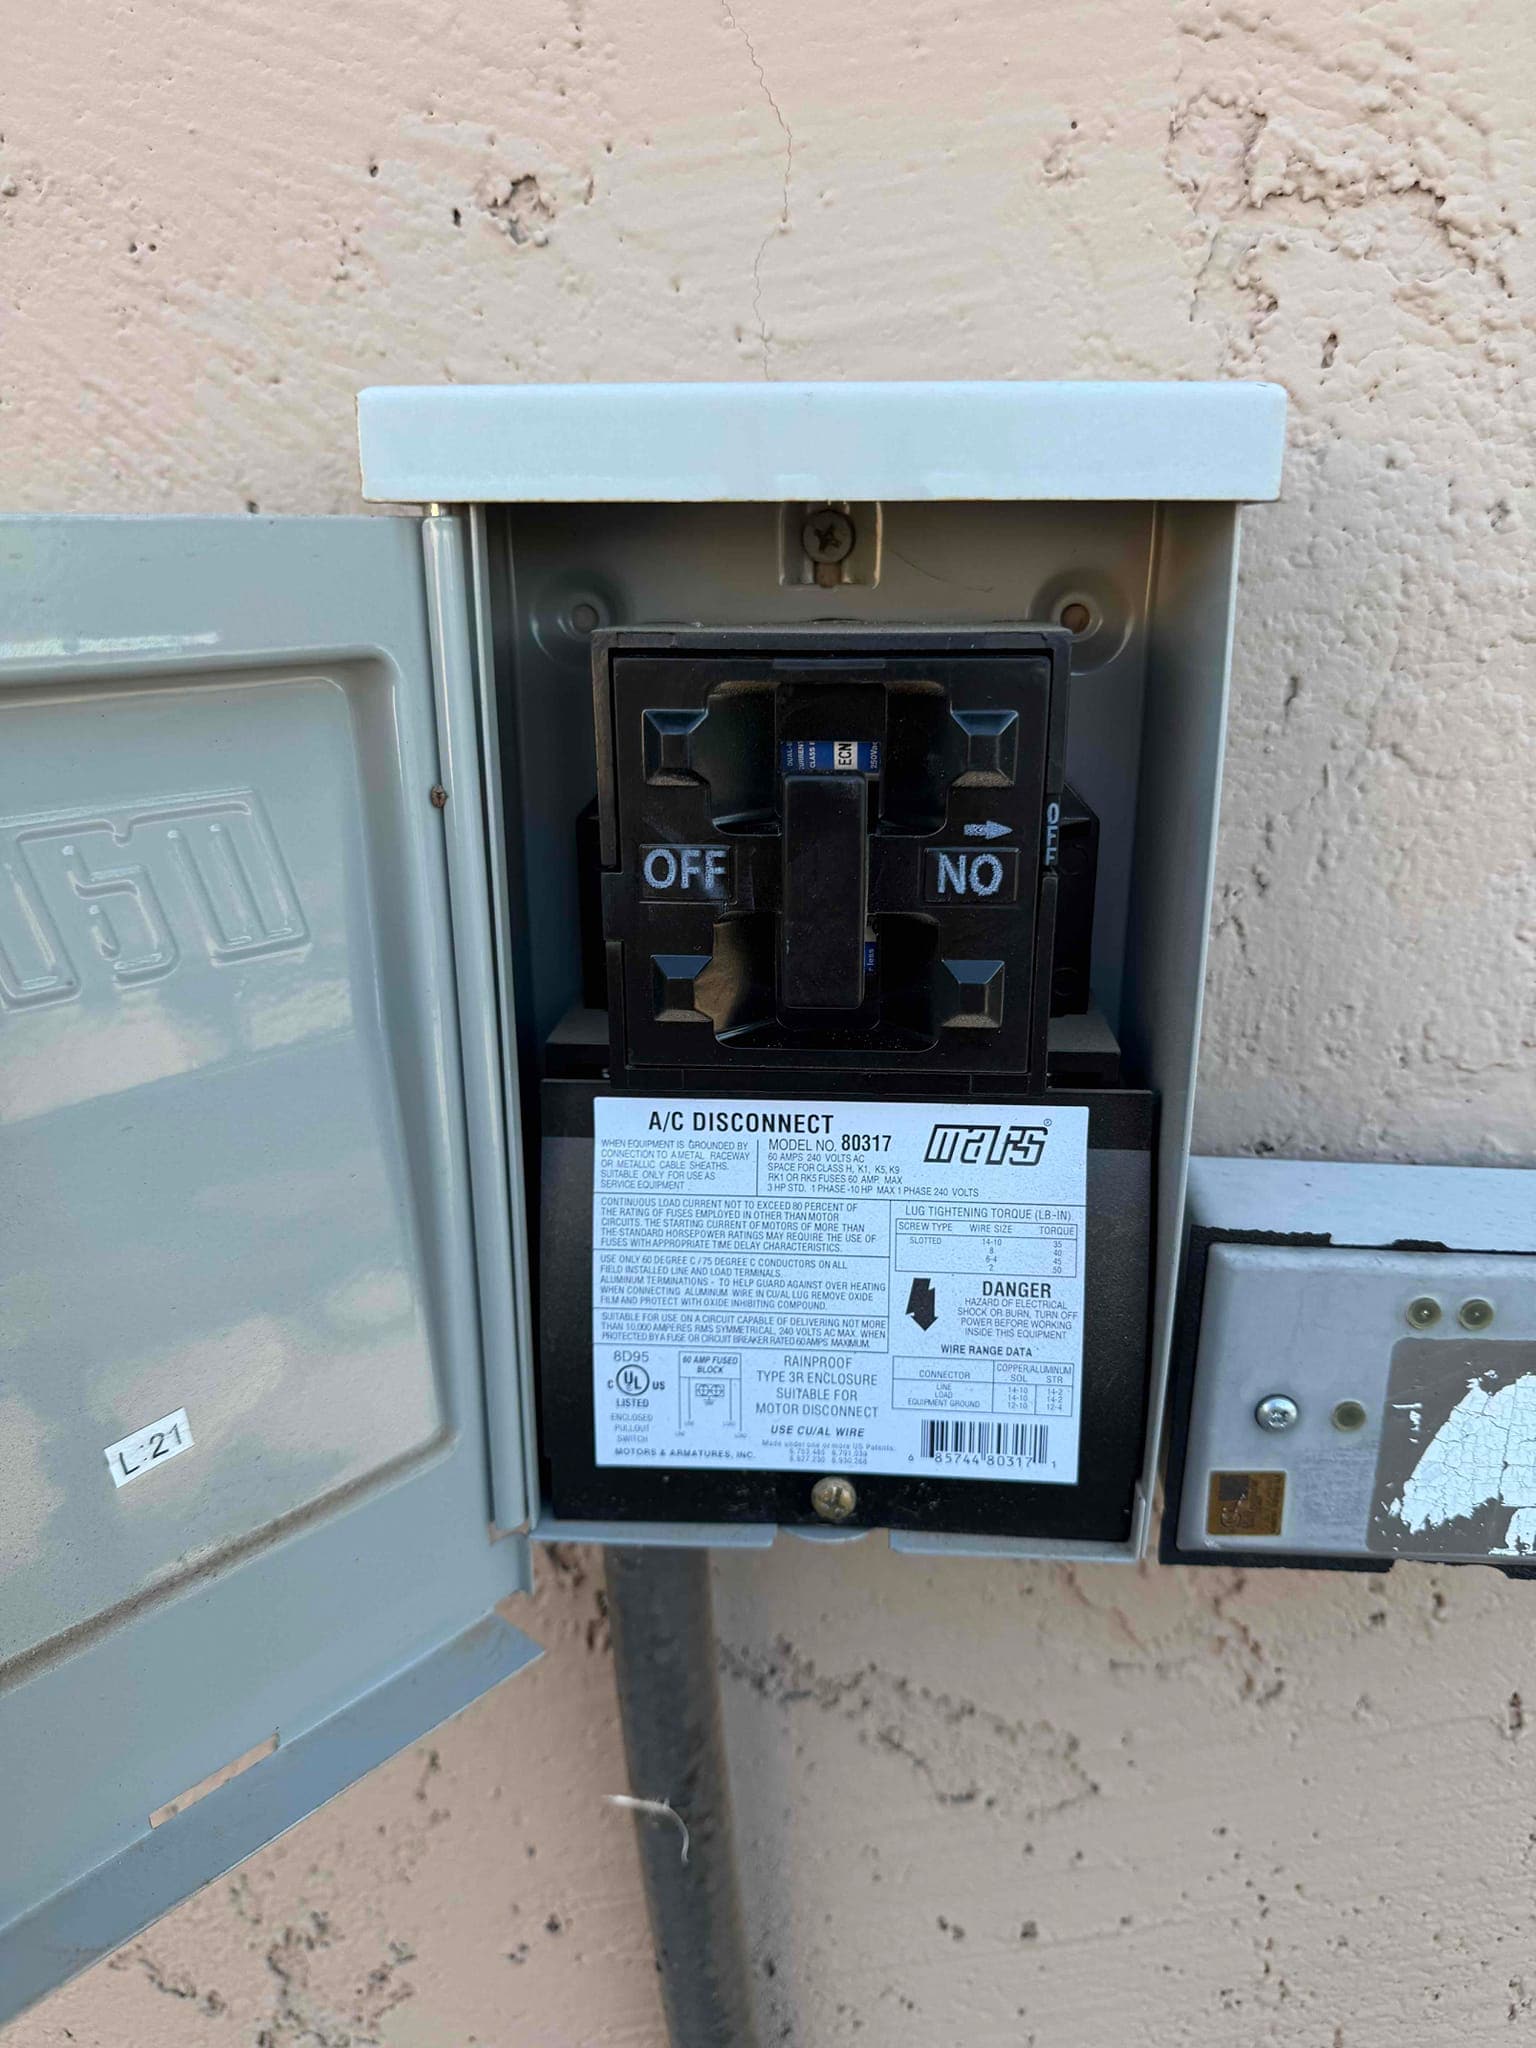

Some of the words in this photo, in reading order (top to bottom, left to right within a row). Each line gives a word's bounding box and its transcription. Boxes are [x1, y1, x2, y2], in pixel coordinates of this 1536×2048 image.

[644, 848, 728, 890] OFF
[648, 1110, 683, 1132] A/C
[693, 1111, 833, 1134] DISCONNECT
[600, 1138, 625, 1147] WHEN
[627, 1138, 674, 1149] EQUIPMENT
[676, 1140, 684, 1149] IS
[688, 1140, 735, 1150] GROUNDED
[737, 1141, 748, 1150] BY
[768, 1137, 812, 1151] MODEL
[816, 1138, 836, 1151] NO.
[841, 1133, 891, 1151] 80317
[600, 1148, 654, 1158] CONNECTION
[656, 1149, 667, 1158] TO
[670, 1150, 676, 1158] A
[677, 1150, 704, 1160] METAL
[710, 1151, 750, 1160] RACEWAY
[767, 1152, 777, 1161] 60
[779, 1152, 803, 1161] AMPS
[806, 1153, 821, 1162] 240
[824, 1153, 851, 1162] VOLTS
[852, 1154, 864, 1163] AC
[600, 1158, 613, 1168] OR
[616, 1158, 655, 1168] METALLIC
[658, 1160, 685, 1170] CABLE
[689, 1160, 729, 1170] SHEATHS.
[767, 1162, 795, 1171] SPACE
[797, 1163, 814, 1172] FOR
[816, 1163, 843, 1173] CLASS
[845, 1164, 854, 1174] H,
[856, 1164, 870, 1174] K1,
[874, 1165, 887, 1174] K5,
[888, 1165, 900, 1174] K9
[600, 1168, 638, 1178] SUITABLE
[640, 1169, 664, 1179] ONLY
[667, 1170, 684, 1179] FOR
[686, 1170, 703, 1180] USE
[704, 1171, 715, 1180] AS
[767, 1172, 783, 1181] RK1
[785, 1173, 798, 1182] OR
[800, 1173, 816, 1182] RK5
[818, 1173, 846, 1183] FUSES
[847, 1174, 857, 1183] 60
[860, 1174, 879, 1184] AMP.
[884, 1175, 902, 1184] MAX
[600, 1178, 635, 1189] SERVICE
[636, 1179, 684, 1190] EQUIPMENT
[767, 1182, 772, 1191] 3
[774, 1182, 786, 1192] HP
[787, 1182, 806, 1192] STD.
[810, 1184, 814, 1192] 1
[817, 1183, 845, 1193] PHASE
[847, 1184, 859, 1193] -10
[860, 1184, 872, 1194] HP
[876, 1185, 895, 1194] MAX
[897, 1186, 901, 1194] 1
[903, 1186, 931, 1195] PHASE
[933, 1187, 948, 1196] 240
[951, 1187, 978, 1198] VOLTS
[906, 1206, 925, 1216] LUG
[928, 1205, 987, 1218] TIGHTENING
[990, 1207, 1032, 1219] TORQUE
[1034, 1209, 1071, 1222] (LB-IN)
[898, 1221, 929, 1231] SCREW
[931, 1222, 952, 1231] TYPE
[969, 1223, 990, 1233] WIRE
[993, 1224, 1012, 1233] SIZE
[1038, 1225, 1074, 1235] TORQUE
[982, 1238, 1002, 1246] 14-10
[1054, 1258, 1062, 1266] 45
[1054, 1266, 1062, 1274] 50
[982, 1280, 1051, 1298] DANGER
[964, 1296, 999, 1308] HAZARD
[1001, 1298, 1013, 1307] OF
[1015, 1298, 1068, 1310] ELECTRICAL
[955, 1306, 987, 1318] SHOCK
[989, 1307, 1003, 1317] OR
[1005, 1308, 1031, 1318] BURN,
[1034, 1309, 1058, 1319] TURN
[1060, 1310, 1078, 1320] OFF
[960, 1316, 992, 1327] POWER
[994, 1318, 1028, 1328] BEFORE
[1030, 1319, 1072, 1330] WORKING
[964, 1326, 994, 1337] INSIDE
[995, 1327, 1014, 1337] THIS
[1016, 1328, 1066, 1339] EQUIPMENT
[940, 1343, 965, 1354] WIRE
[968, 1345, 1003, 1355] RANGE
[1005, 1346, 1032, 1356] DATA
[612, 1349, 649, 1363] 8D95
[682, 1355, 691, 1363] 60
[693, 1355, 710, 1365] AMP
[711, 1356, 738, 1365] FUSED
[784, 1354, 852, 1369] RAINPROOF
[696, 1364, 724, 1374] BLOCK
[919, 1370, 970, 1380] CONNECTOR
[624, 1371, 642, 1390] UL
[756, 1369, 785, 1382] TYPE
[788, 1370, 804, 1383] 3R
[807, 1371, 877, 1386] ENCLOSURE
[1010, 1374, 1028, 1382] SOL
[1046, 1376, 1064, 1384] STR
[652, 1381, 665, 1390] US
[936, 1382, 951, 1391] LINE
[1008, 1386, 1028, 1394] 14-10
[776, 1386, 829, 1400] SUITABLE
[833, 1388, 857, 1402] FOR
[616, 1397, 648, 1408] LISTED
[907, 1397, 947, 1407] EQUIPMENT
[949, 1399, 980, 1408] GROUND
[755, 1401, 798, 1415] MOTOR
[802, 1403, 878, 1418] DISCONNECT
[770, 1424, 793, 1434] USE
[797, 1425, 830, 1436] CU/AL
[835, 1426, 864, 1437] WIRE
[120, 1423, 182, 1475] L:21
[614, 1446, 656, 1457] MOTORS
[659, 1448, 666, 1456] &
[669, 1448, 733, 1458] ARMATURES,
[736, 1450, 755, 1459] INC.
[935, 1453, 979, 1464] 85744
[987, 1455, 1032, 1467] 80317
